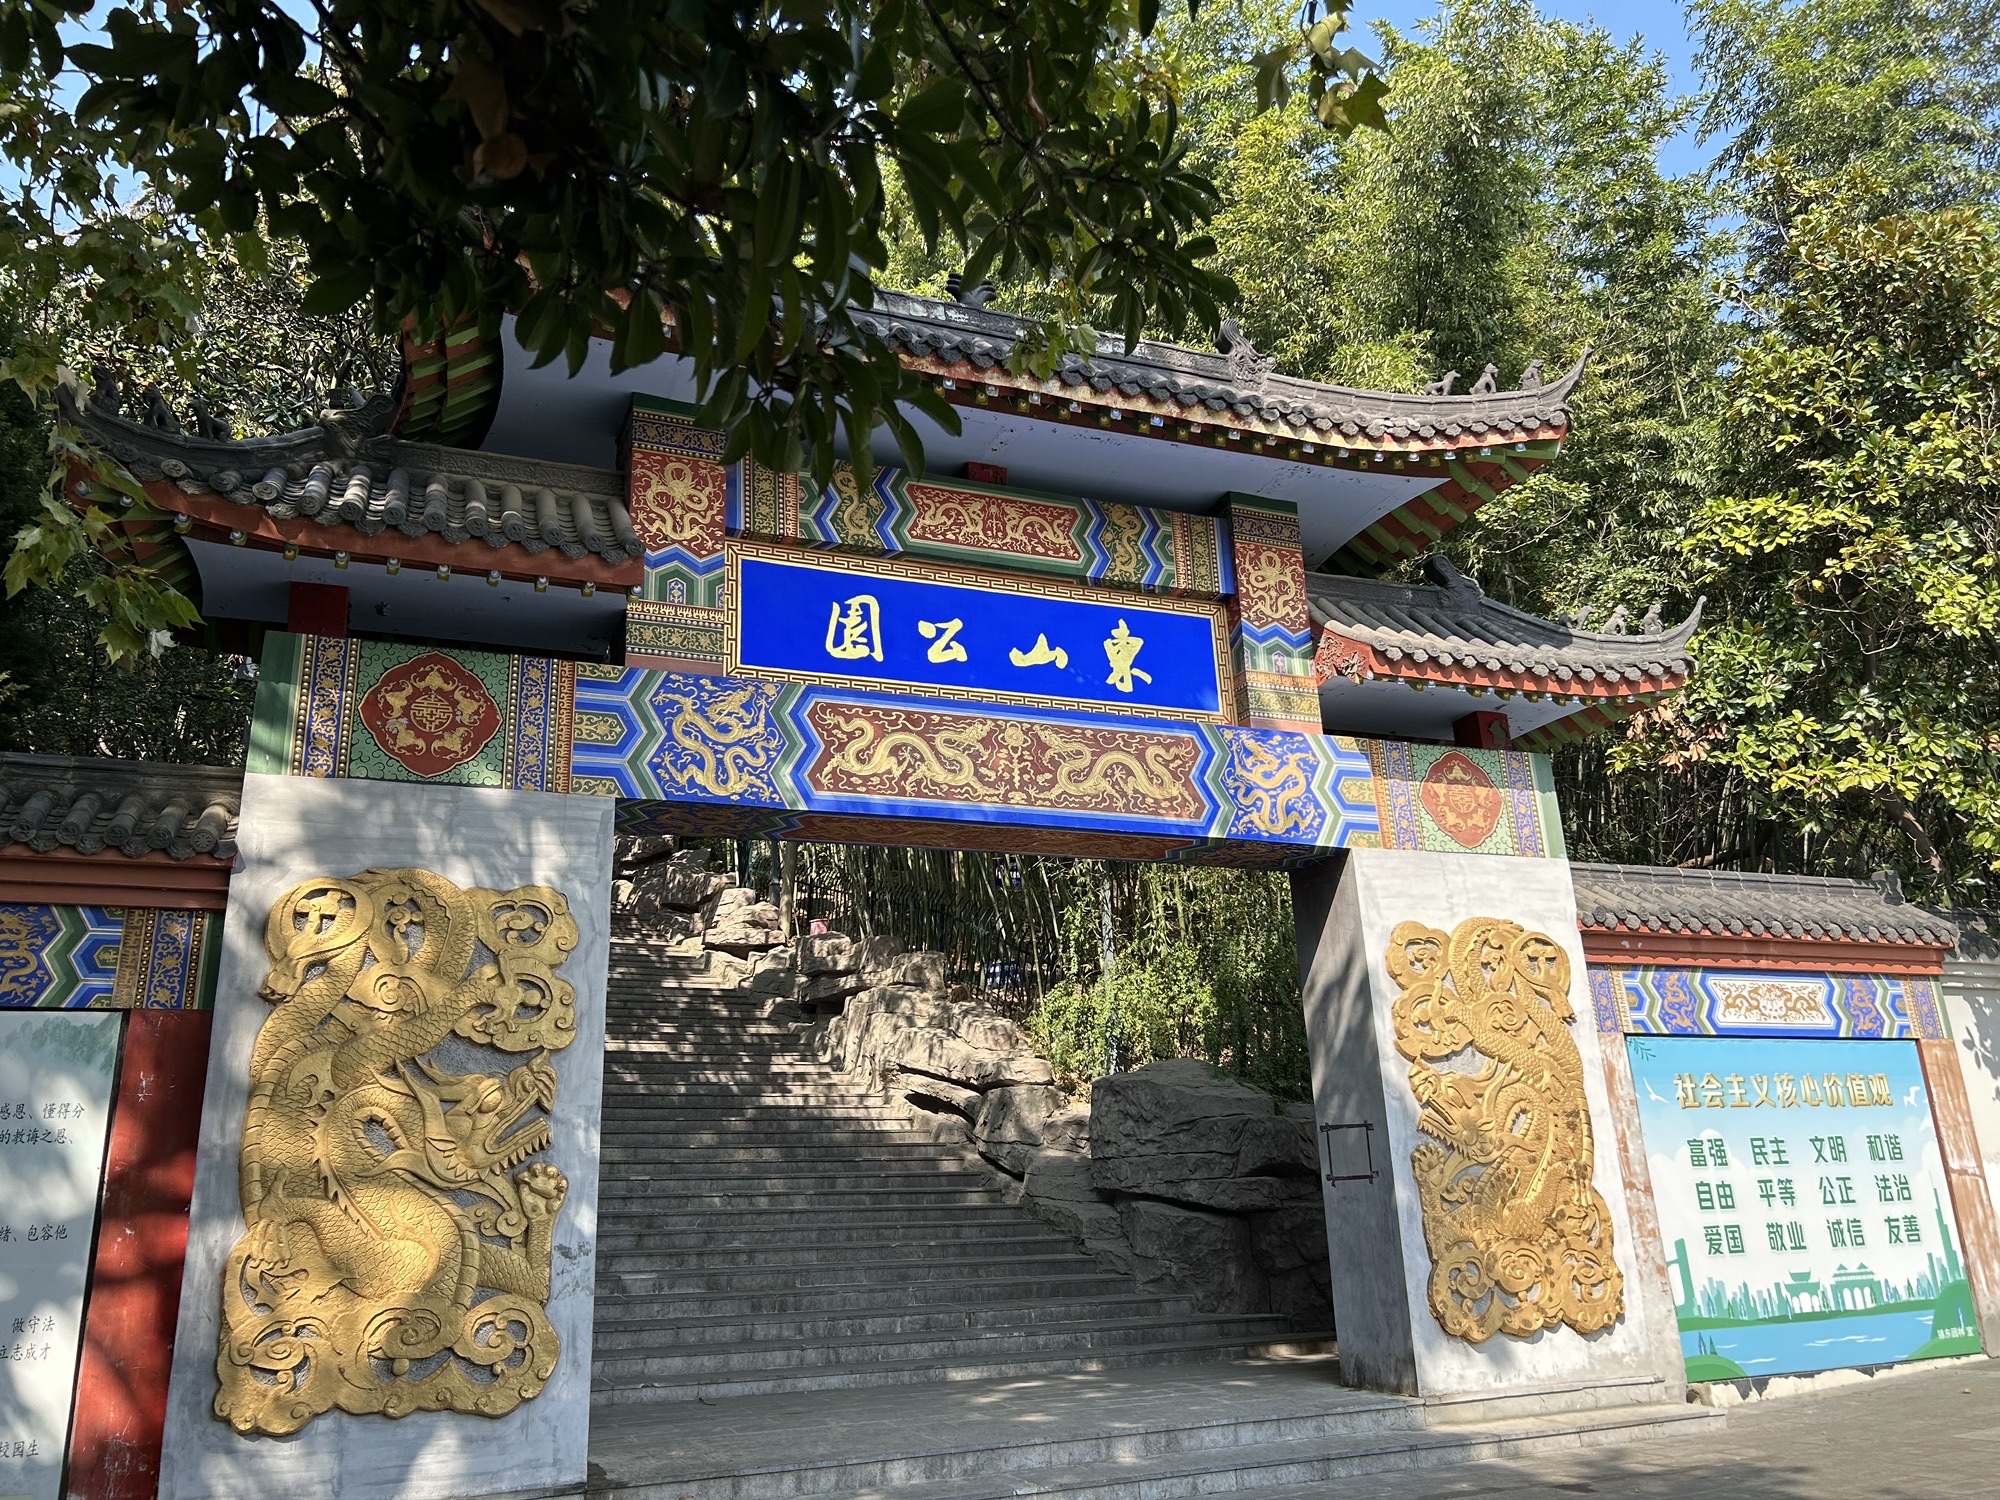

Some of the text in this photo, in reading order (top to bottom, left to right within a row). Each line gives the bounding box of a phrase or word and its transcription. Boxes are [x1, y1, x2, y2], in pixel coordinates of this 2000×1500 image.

[1673, 1072, 1894, 1109] 社会主义核心价值观
[1687, 1133, 1904, 1167] 富强 民主 文明 和谐
[1695, 1173, 1912, 1210] 自由 平等 公正 法治
[1703, 1214, 1921, 1255] 爱国 敬业 诚信 友善
